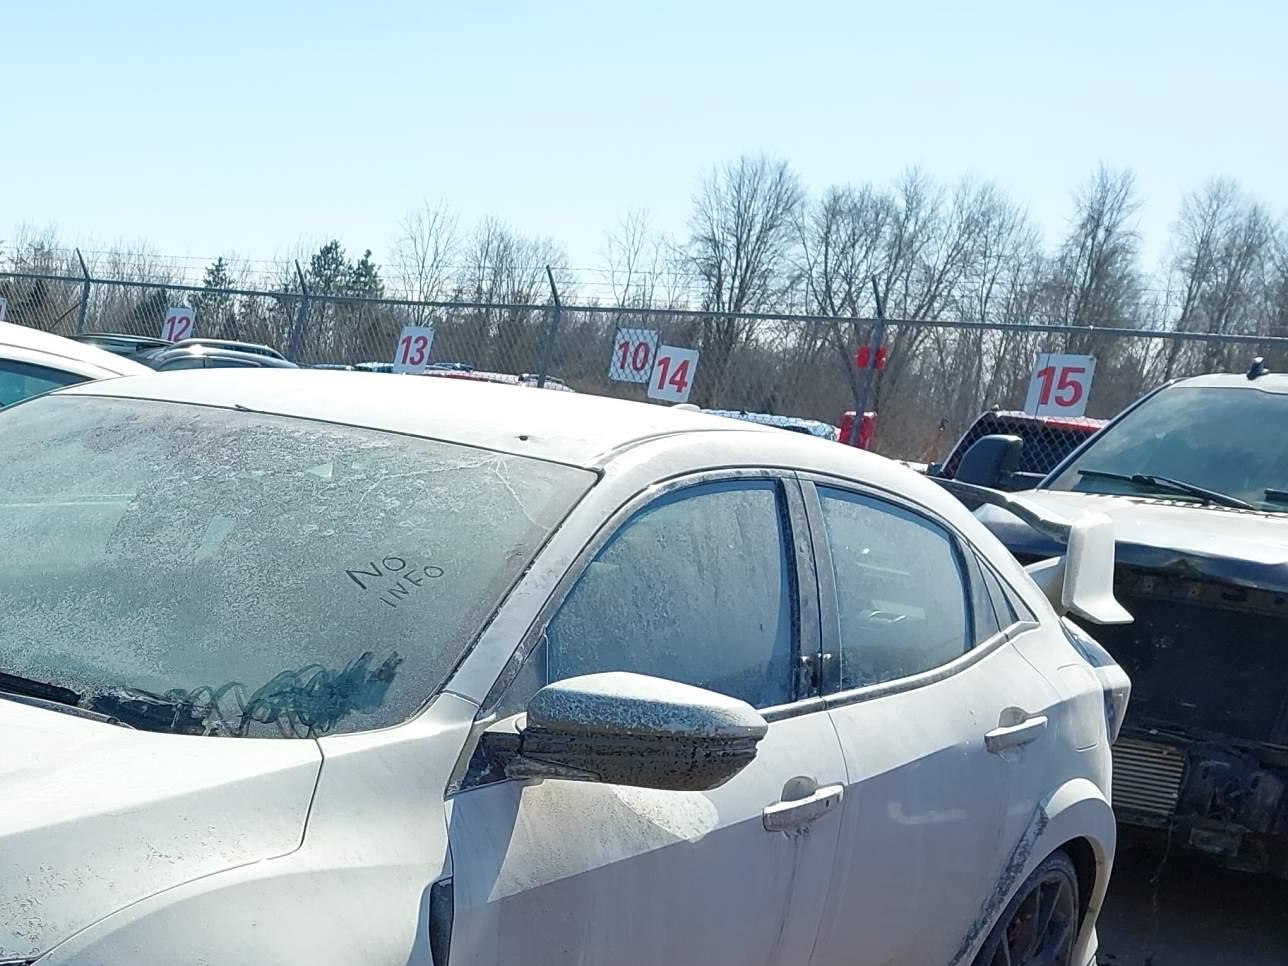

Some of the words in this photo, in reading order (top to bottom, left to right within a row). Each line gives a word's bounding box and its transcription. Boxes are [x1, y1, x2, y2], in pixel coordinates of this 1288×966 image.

[166, 315, 190, 342] 12
[400, 335, 428, 366] 13
[617, 340, 650, 372] 10
[656, 356, 690, 394] 14
[1036, 366, 1087, 407] 15
[345, 556, 406, 590] NO
[379, 566, 444, 608] INFO
